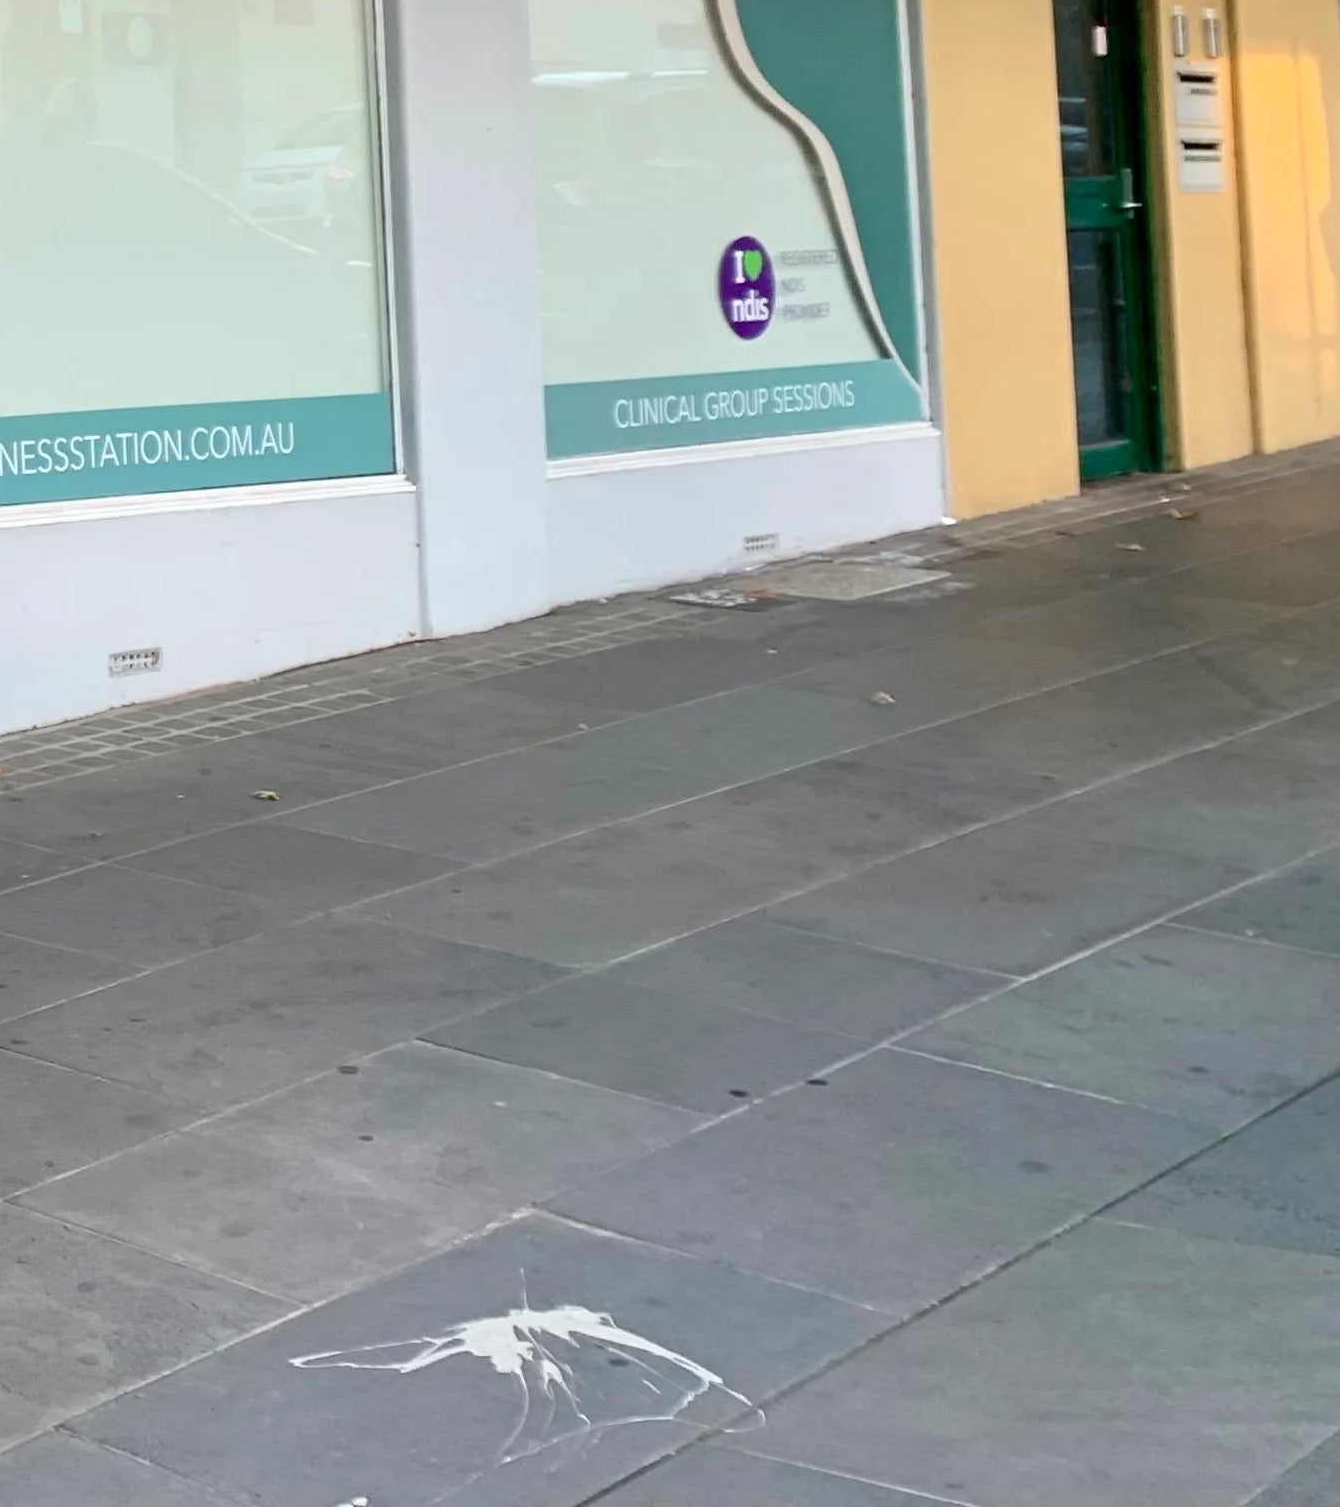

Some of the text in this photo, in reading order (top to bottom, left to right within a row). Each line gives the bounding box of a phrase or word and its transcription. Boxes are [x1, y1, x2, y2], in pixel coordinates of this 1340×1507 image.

[732, 289, 770, 323] ndis
[614, 380, 856, 429] CLINICAL GROUP SESSIONS
